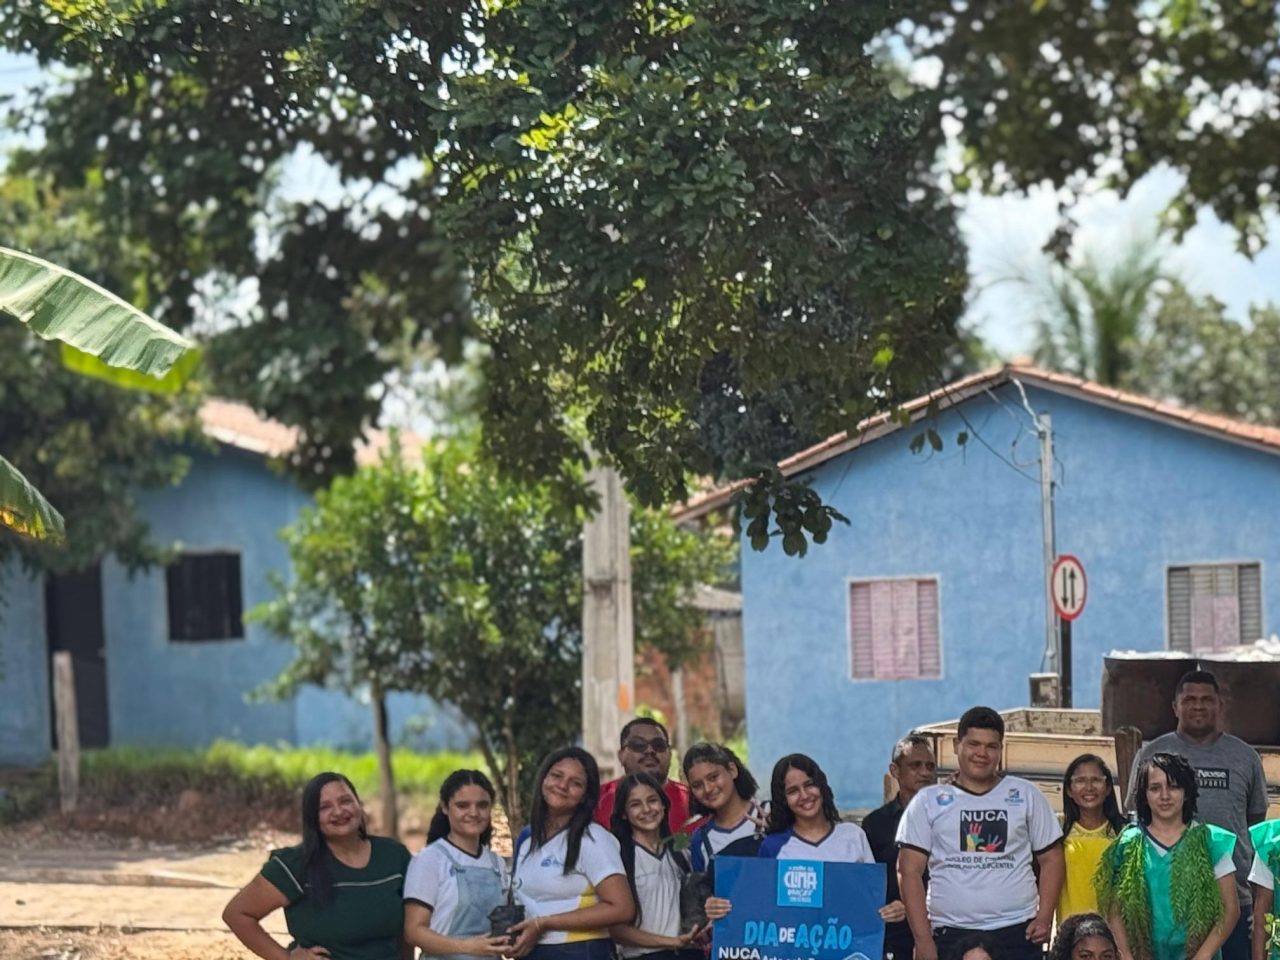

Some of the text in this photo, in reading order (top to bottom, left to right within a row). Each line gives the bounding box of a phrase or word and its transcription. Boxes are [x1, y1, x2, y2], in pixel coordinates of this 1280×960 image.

[961, 811, 1008, 822] NUCA
[744, 917, 853, 955] DIA DE AÇÃO
[718, 947, 760, 960] NUCA
